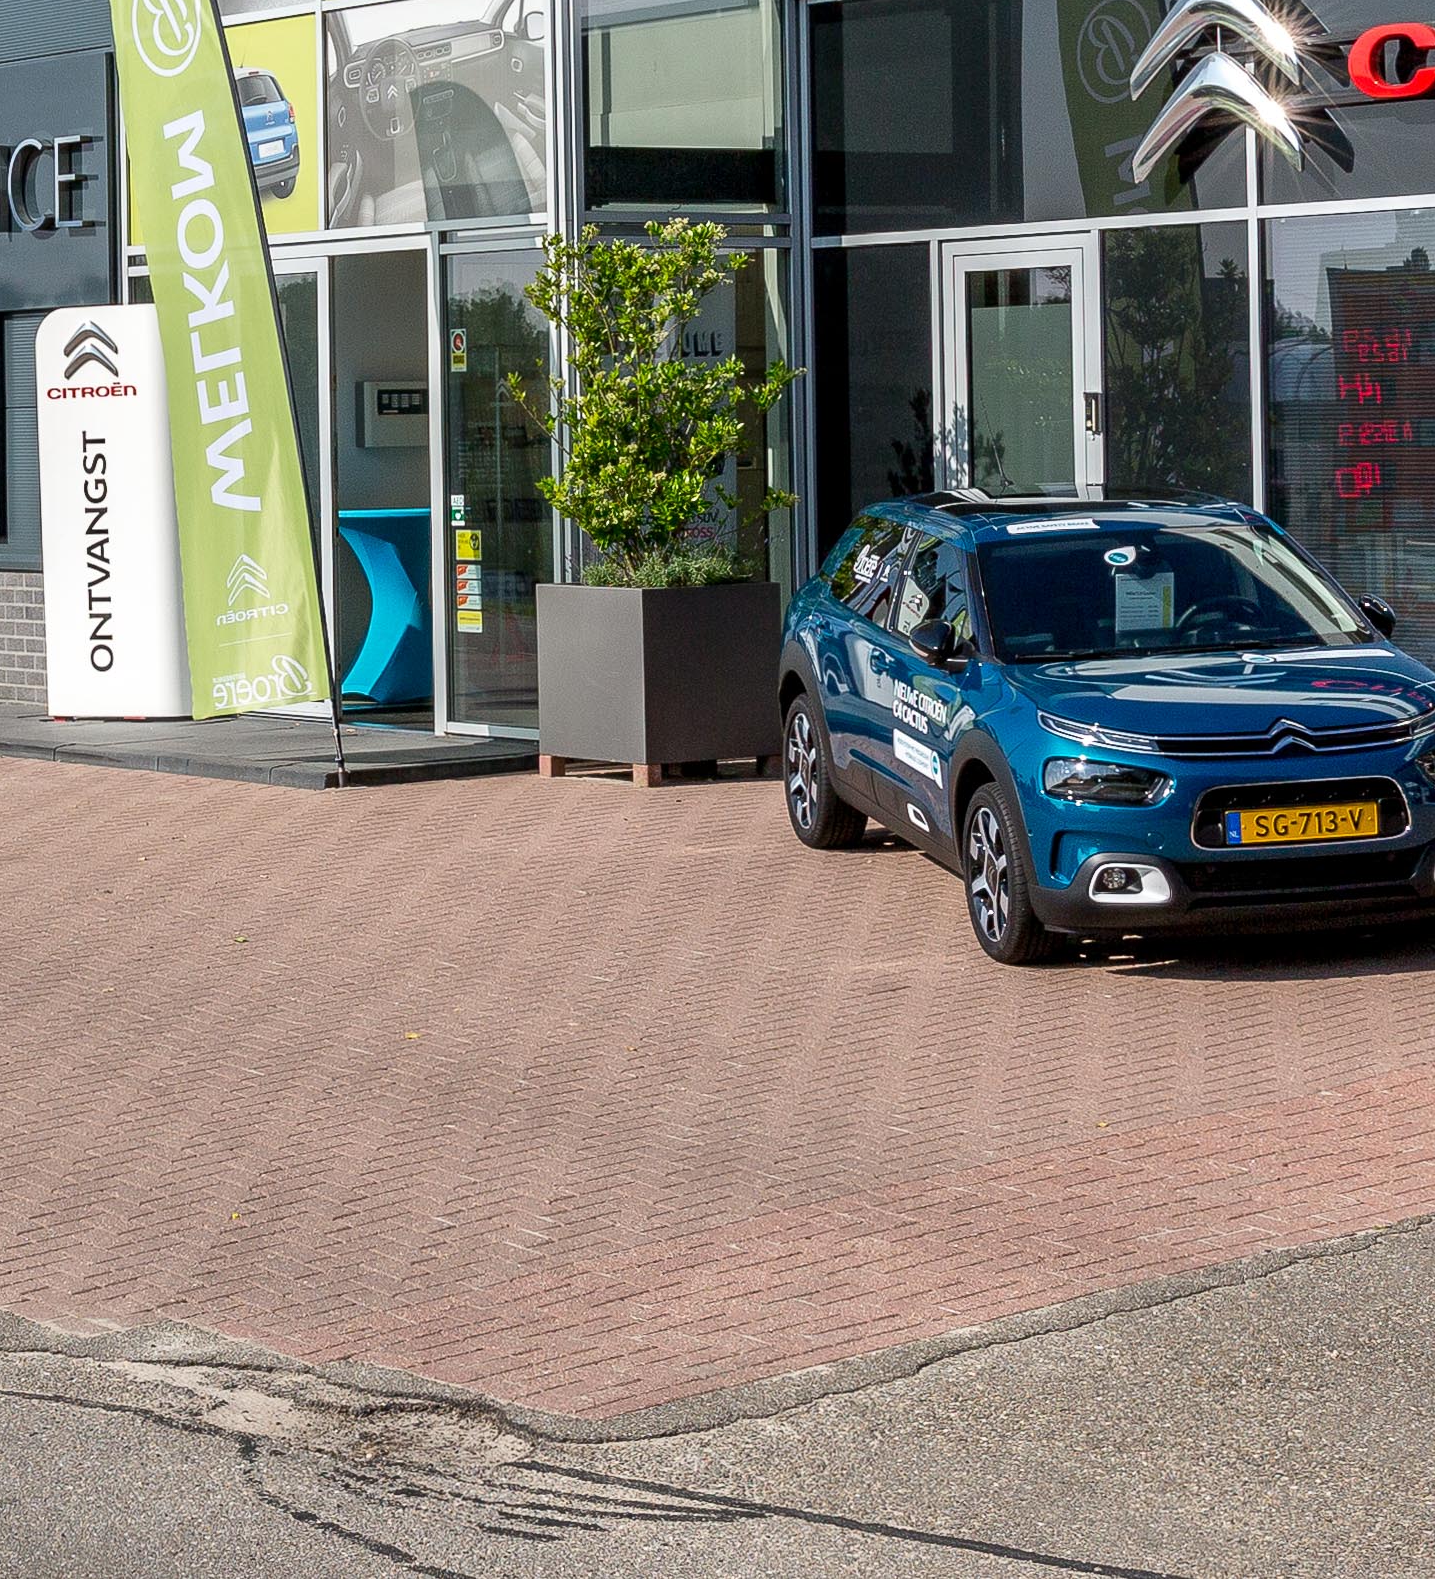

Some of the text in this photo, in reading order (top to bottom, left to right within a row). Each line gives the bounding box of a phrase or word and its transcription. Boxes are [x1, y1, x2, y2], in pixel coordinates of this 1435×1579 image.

[46, 381, 138, 400] CITROËN
[81, 430, 115, 673] ONTVANGST
[1253, 808, 1364, 838] SG-713-V
